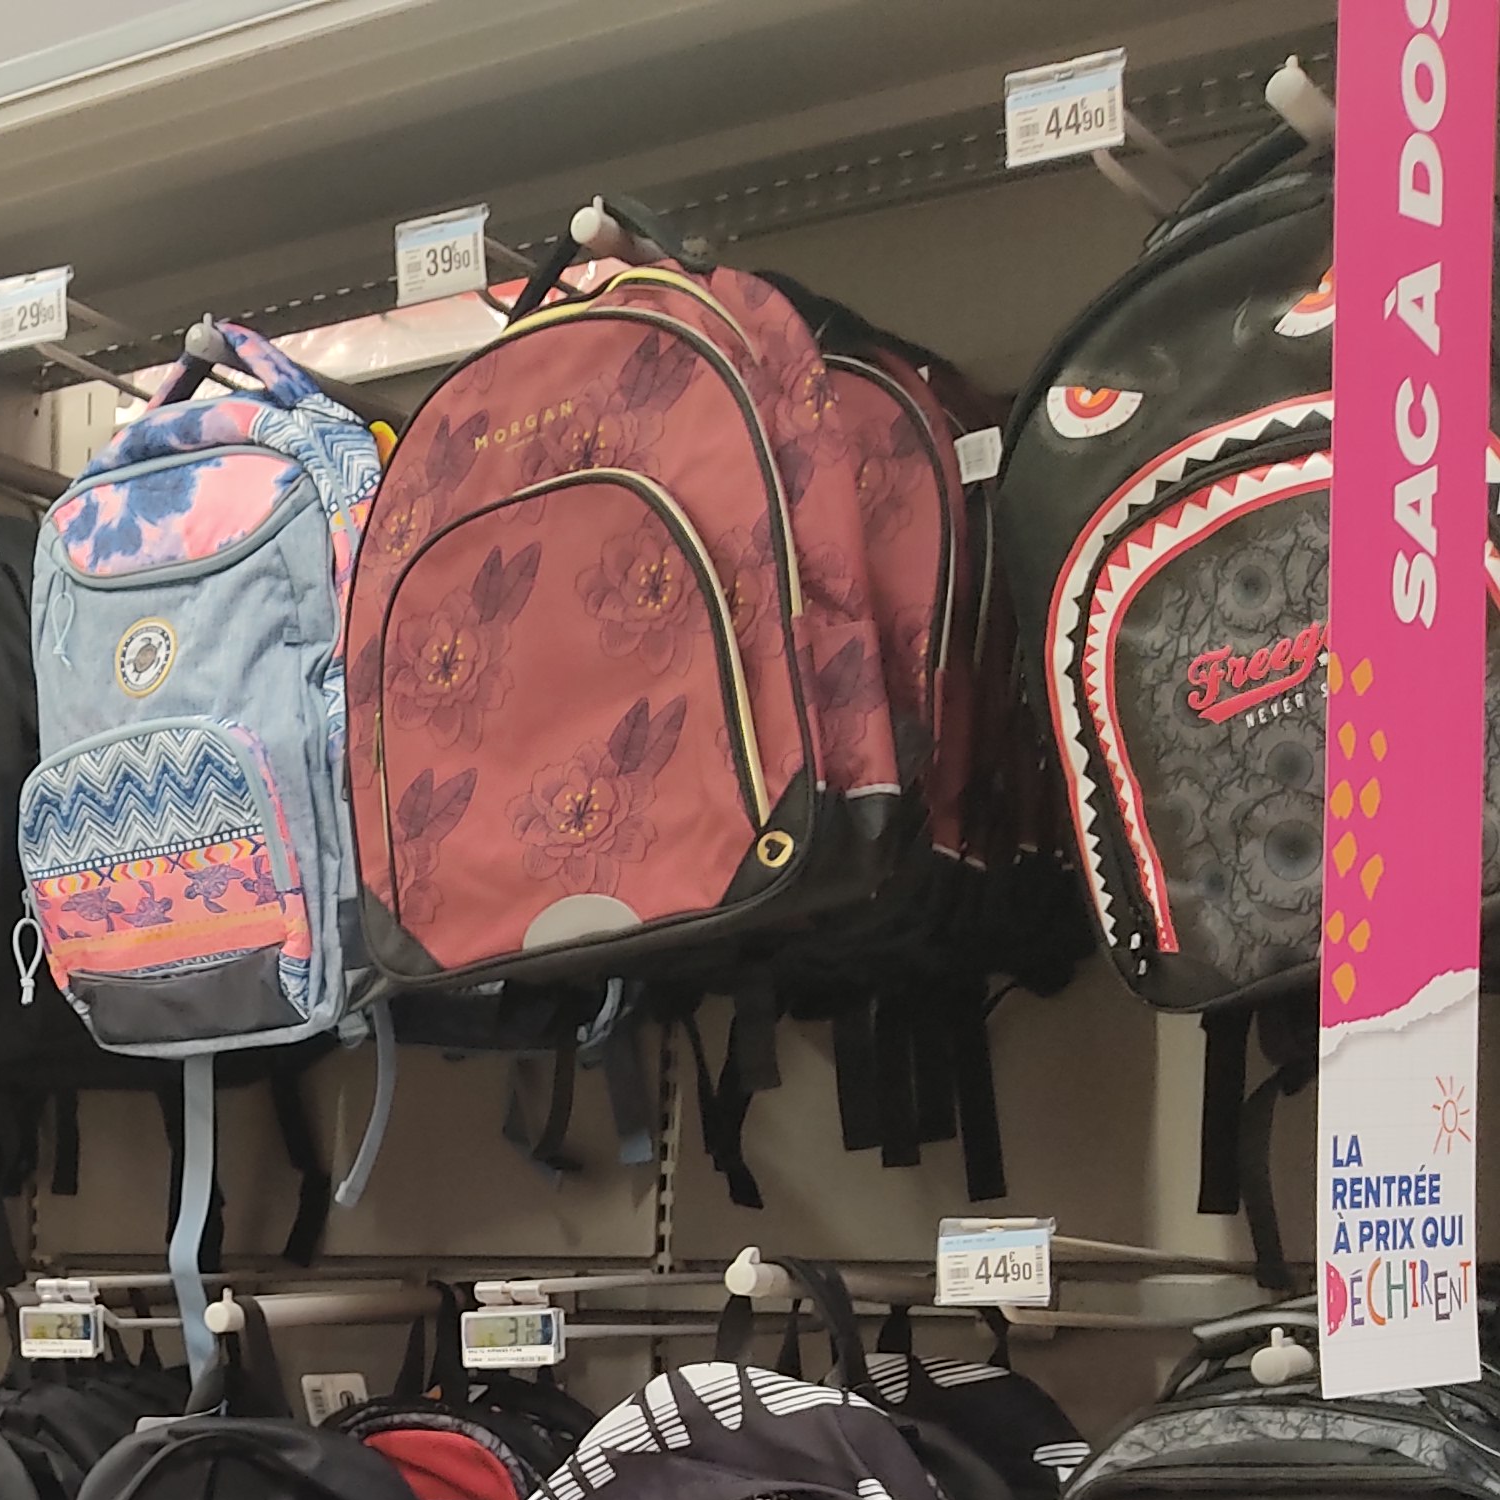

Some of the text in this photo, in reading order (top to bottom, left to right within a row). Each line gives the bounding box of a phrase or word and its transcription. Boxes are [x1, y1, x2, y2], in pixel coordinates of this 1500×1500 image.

[1384, 261, 1441, 356] À
[473, 400, 573, 452] MORGAN
[1392, 377, 1440, 629] SAC
[1187, 620, 1329, 714] Freeg
[1245, 692, 1305, 729] NEVER
[1332, 1134, 1363, 1168] LA
[1332, 1164, 1441, 1211] RENTRÉE
[1333, 1212, 1463, 1255] À PRIX QUI
[1325, 1256, 1472, 1337] DÉCHIRENT
